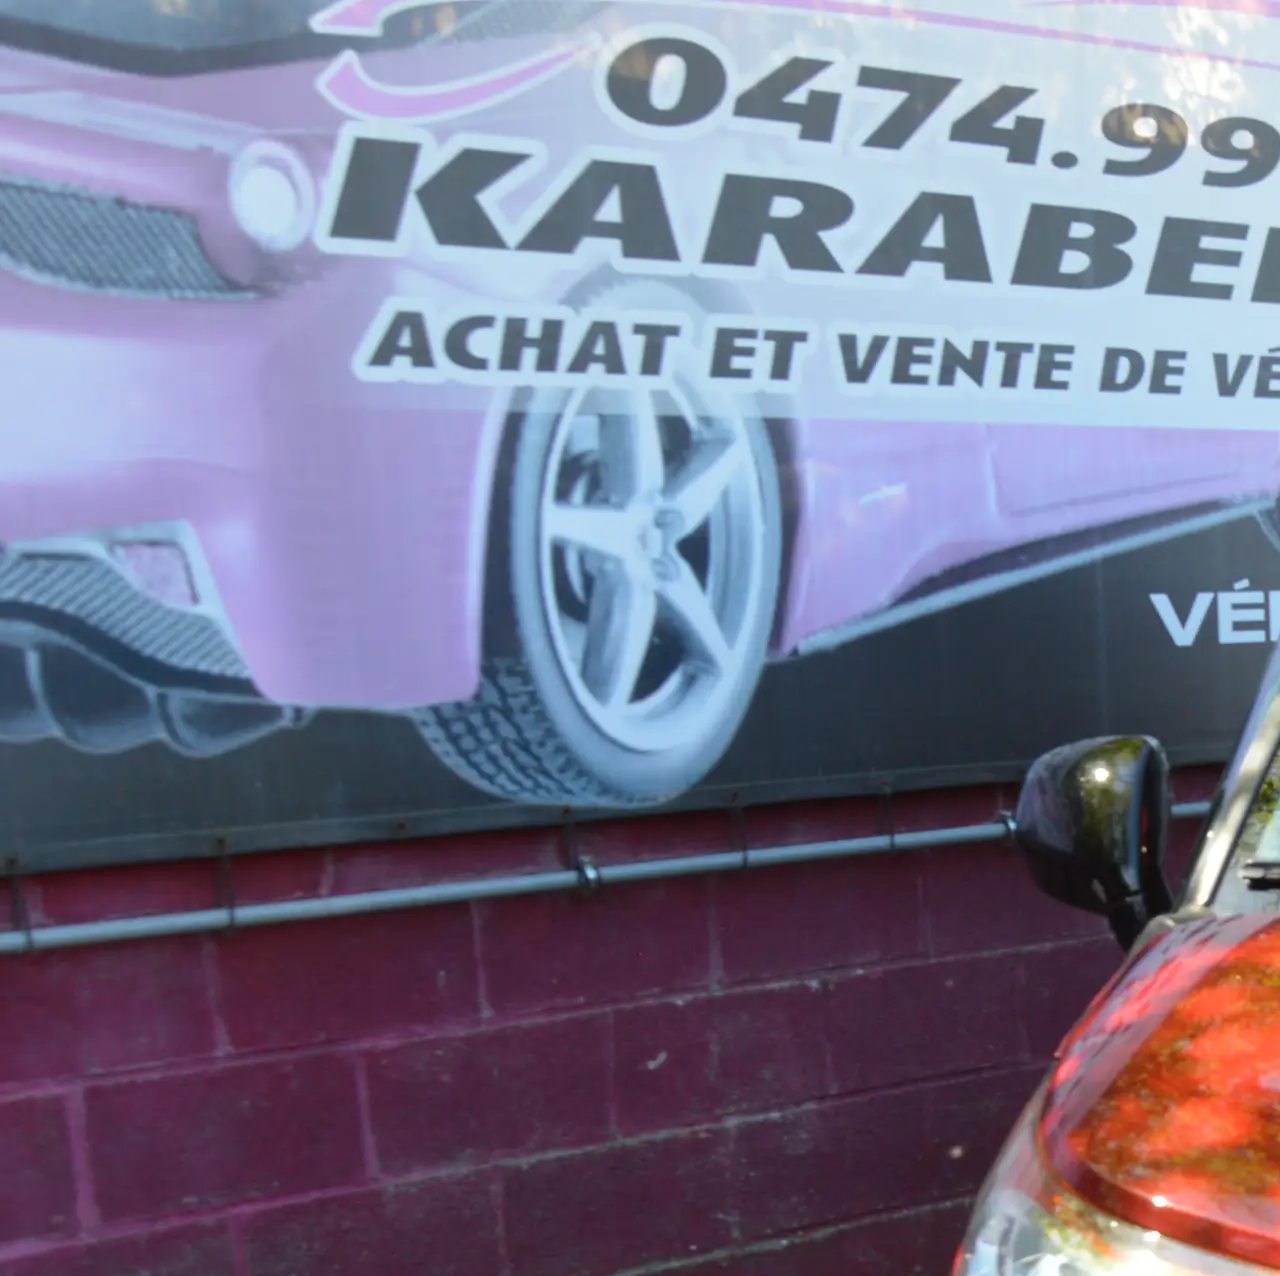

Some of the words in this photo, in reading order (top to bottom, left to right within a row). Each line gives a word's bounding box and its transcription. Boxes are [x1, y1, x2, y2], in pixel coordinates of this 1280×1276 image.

[369, 310, 681, 377] ACHAT
[709, 327, 808, 383] ET
[840, 333, 1075, 392] VENTE
[1098, 348, 1188, 396] DE
